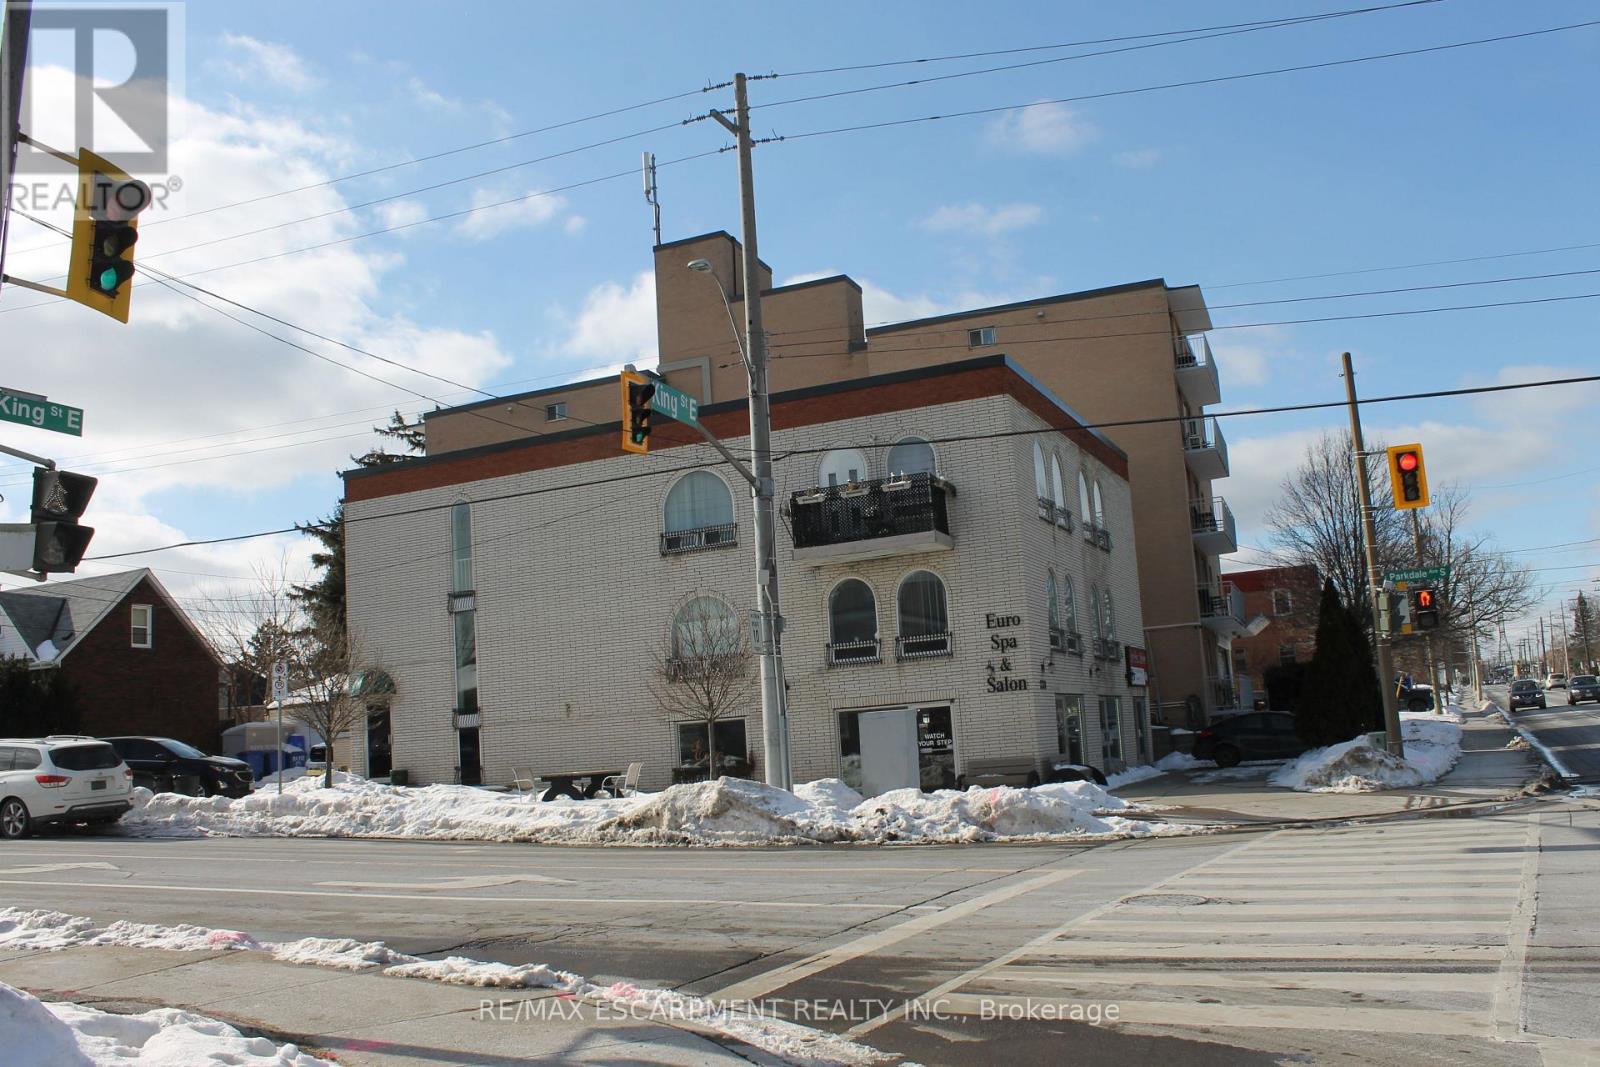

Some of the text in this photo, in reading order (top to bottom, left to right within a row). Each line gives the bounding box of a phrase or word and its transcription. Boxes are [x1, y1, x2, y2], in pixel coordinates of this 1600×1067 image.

[652, 382, 697, 421] King St E
[50, 406, 63, 417] St
[67, 410, 81, 429] E
[1389, 570, 1427, 580] Parkdale
[1440, 567, 1446, 576] S
[985, 613, 1021, 629] Euro
[990, 634, 1018, 654] Spa
[1000, 657, 1014, 672] &
[986, 676, 1028, 694] Salon
[936, 738, 953, 746] STEP
